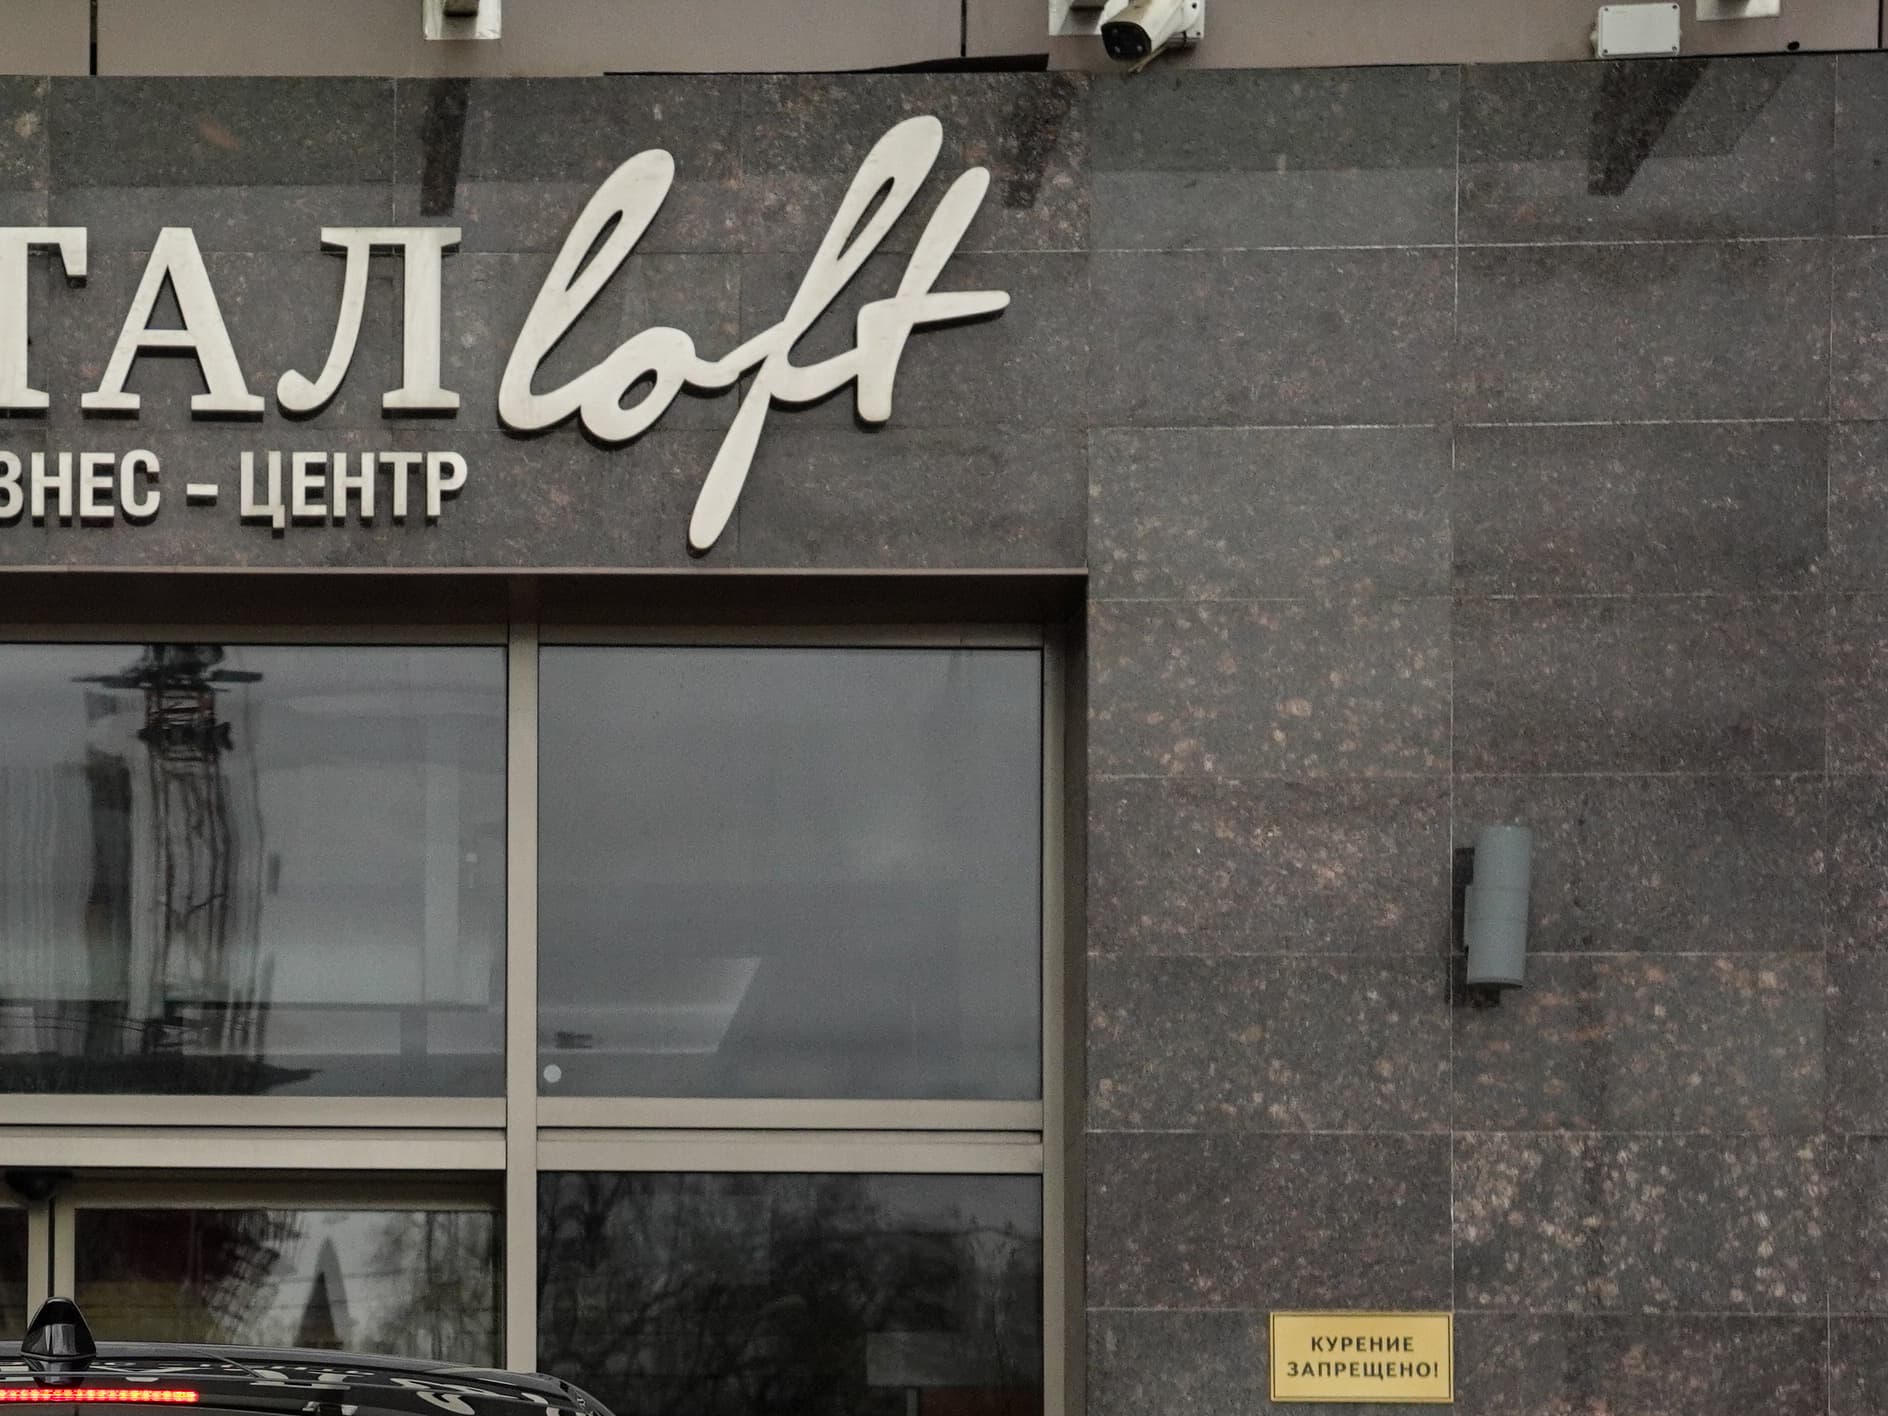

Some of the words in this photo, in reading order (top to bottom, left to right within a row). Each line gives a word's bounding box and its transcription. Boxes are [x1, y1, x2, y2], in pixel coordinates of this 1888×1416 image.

[498, 115, 1011, 553] loft
[238, 451, 468, 530] ЦЕНТР
[1311, 1336, 1415, 1353] КУРЕНИЕ
[1286, 1362, 1439, 1381] ЗАПРЕЩЕНО!
